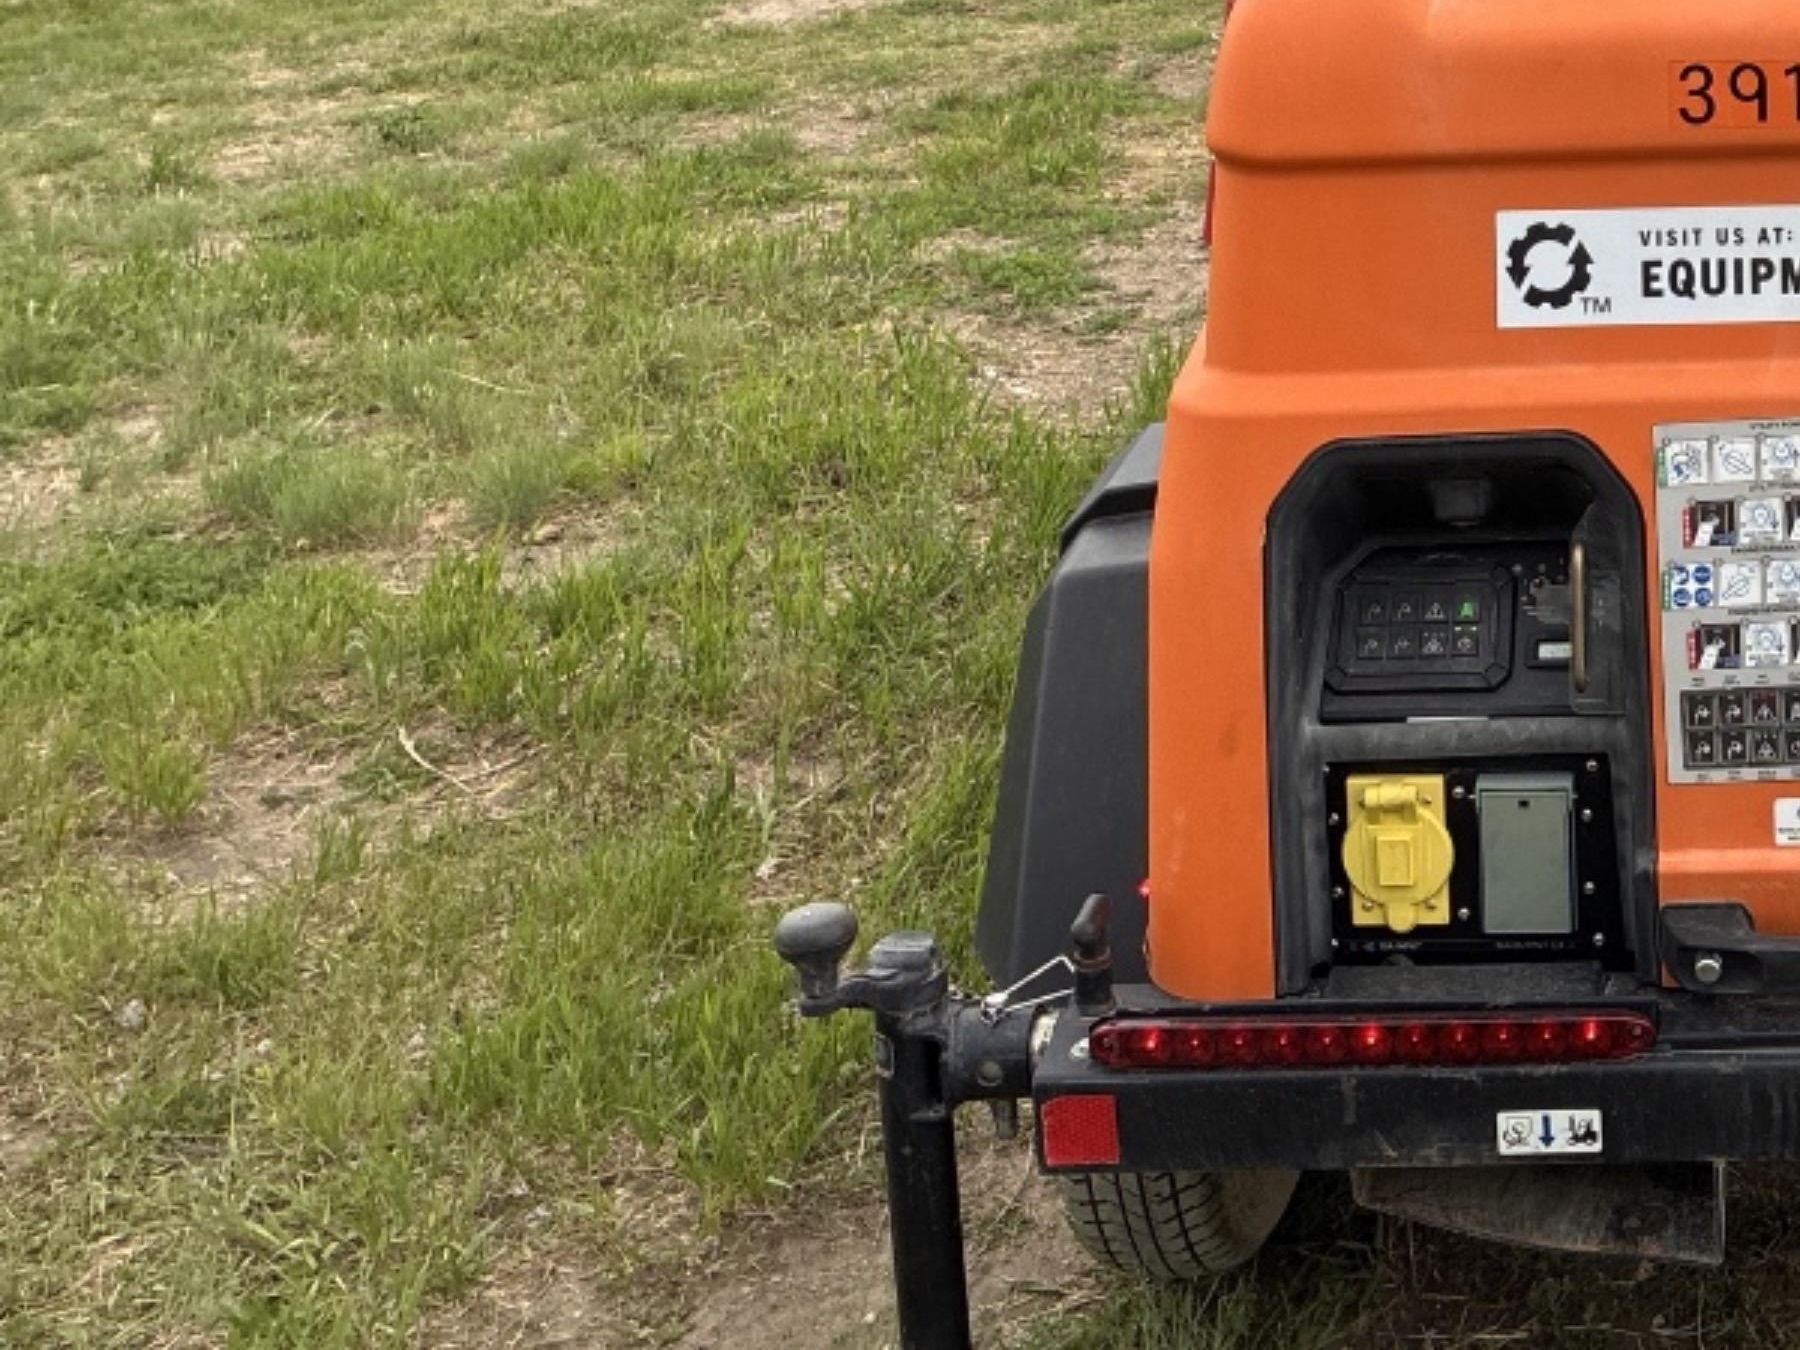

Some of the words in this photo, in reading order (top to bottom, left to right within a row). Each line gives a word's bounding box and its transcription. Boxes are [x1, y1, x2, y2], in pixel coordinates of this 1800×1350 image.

[1638, 228, 1703, 247] VISIT
[1715, 227, 1745, 246] US
[1757, 226, 1794, 246] AT:
